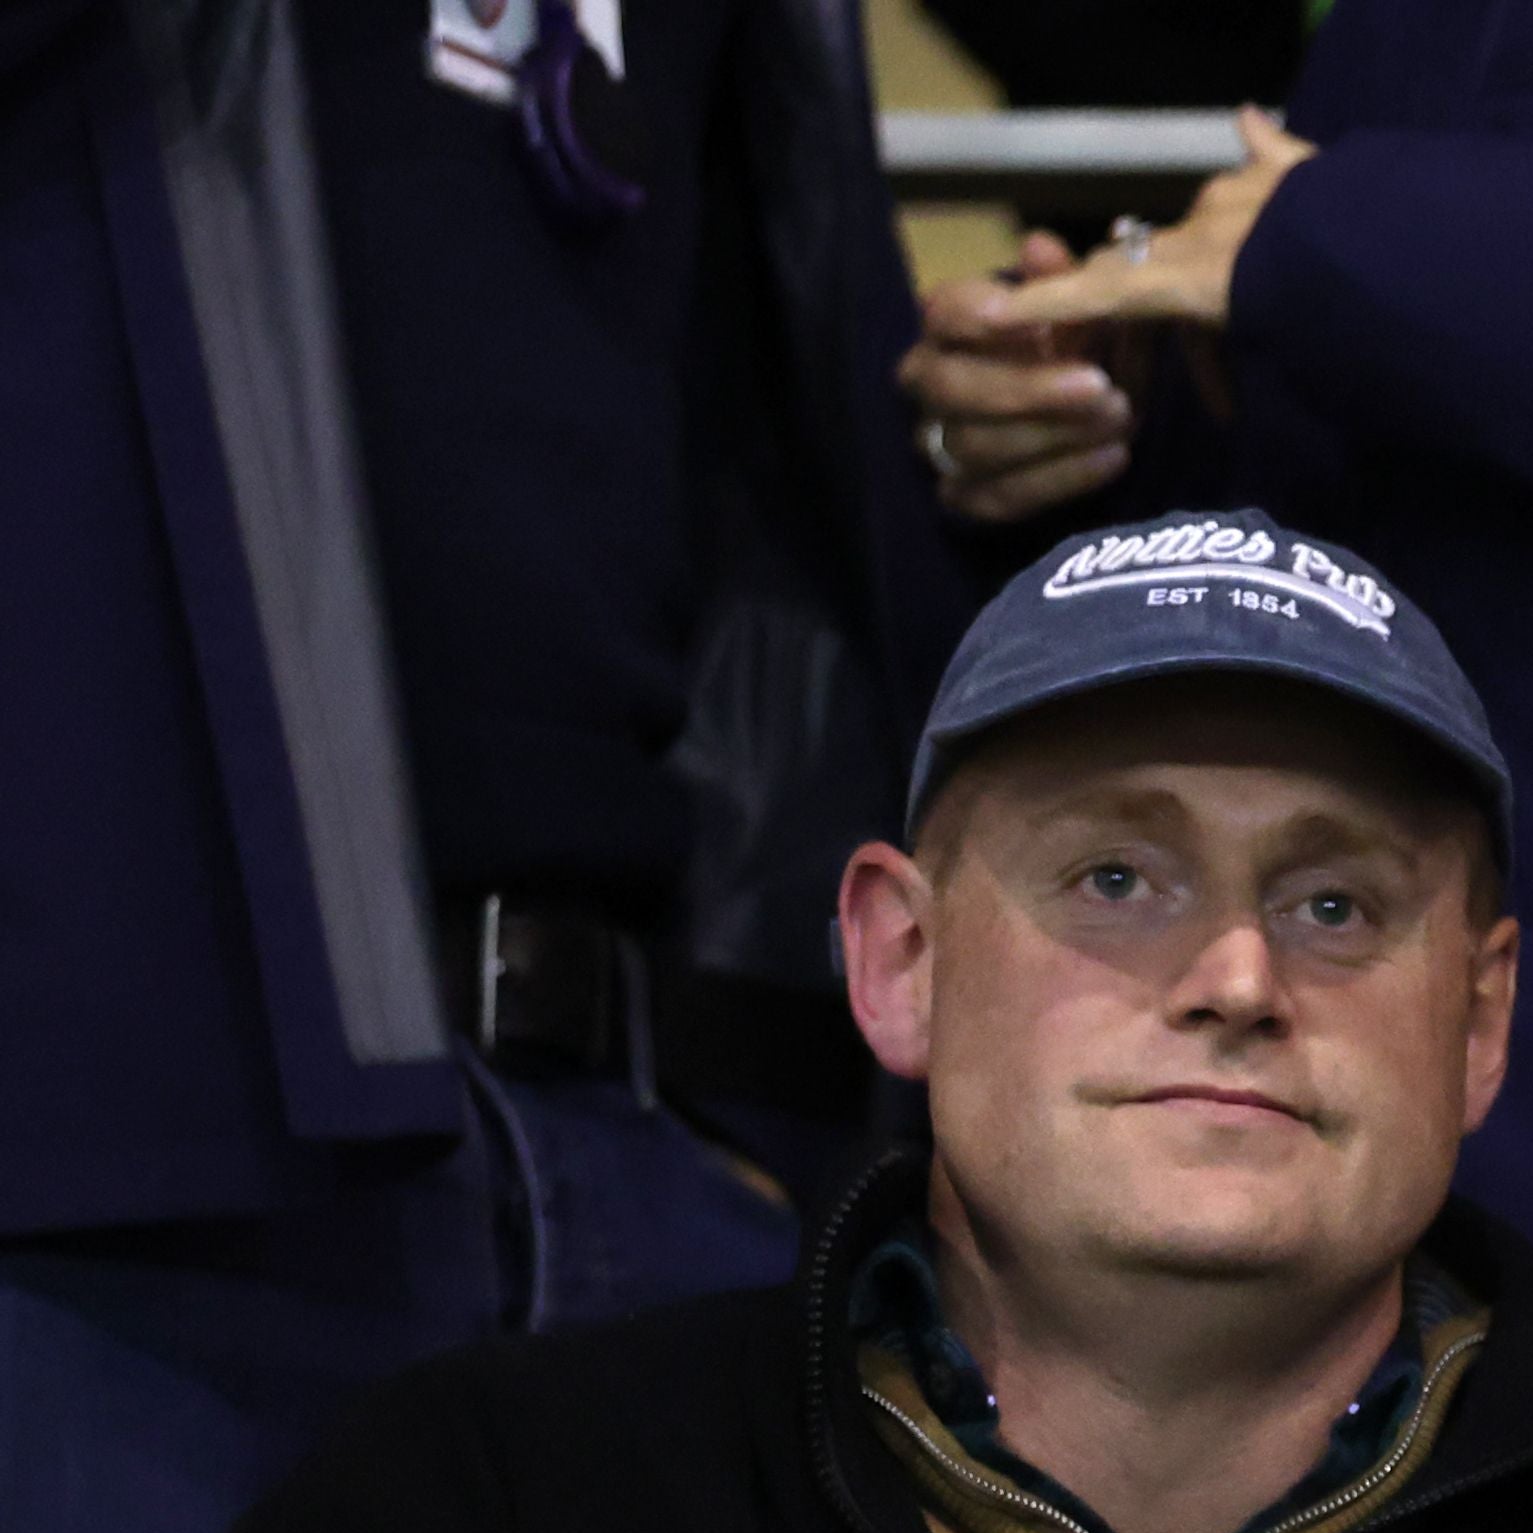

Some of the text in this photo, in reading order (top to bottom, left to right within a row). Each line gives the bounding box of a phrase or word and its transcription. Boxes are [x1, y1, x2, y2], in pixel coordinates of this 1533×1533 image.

[1147, 587, 1300, 619] EST 1854
[1290, 543, 1396, 618] Pub
